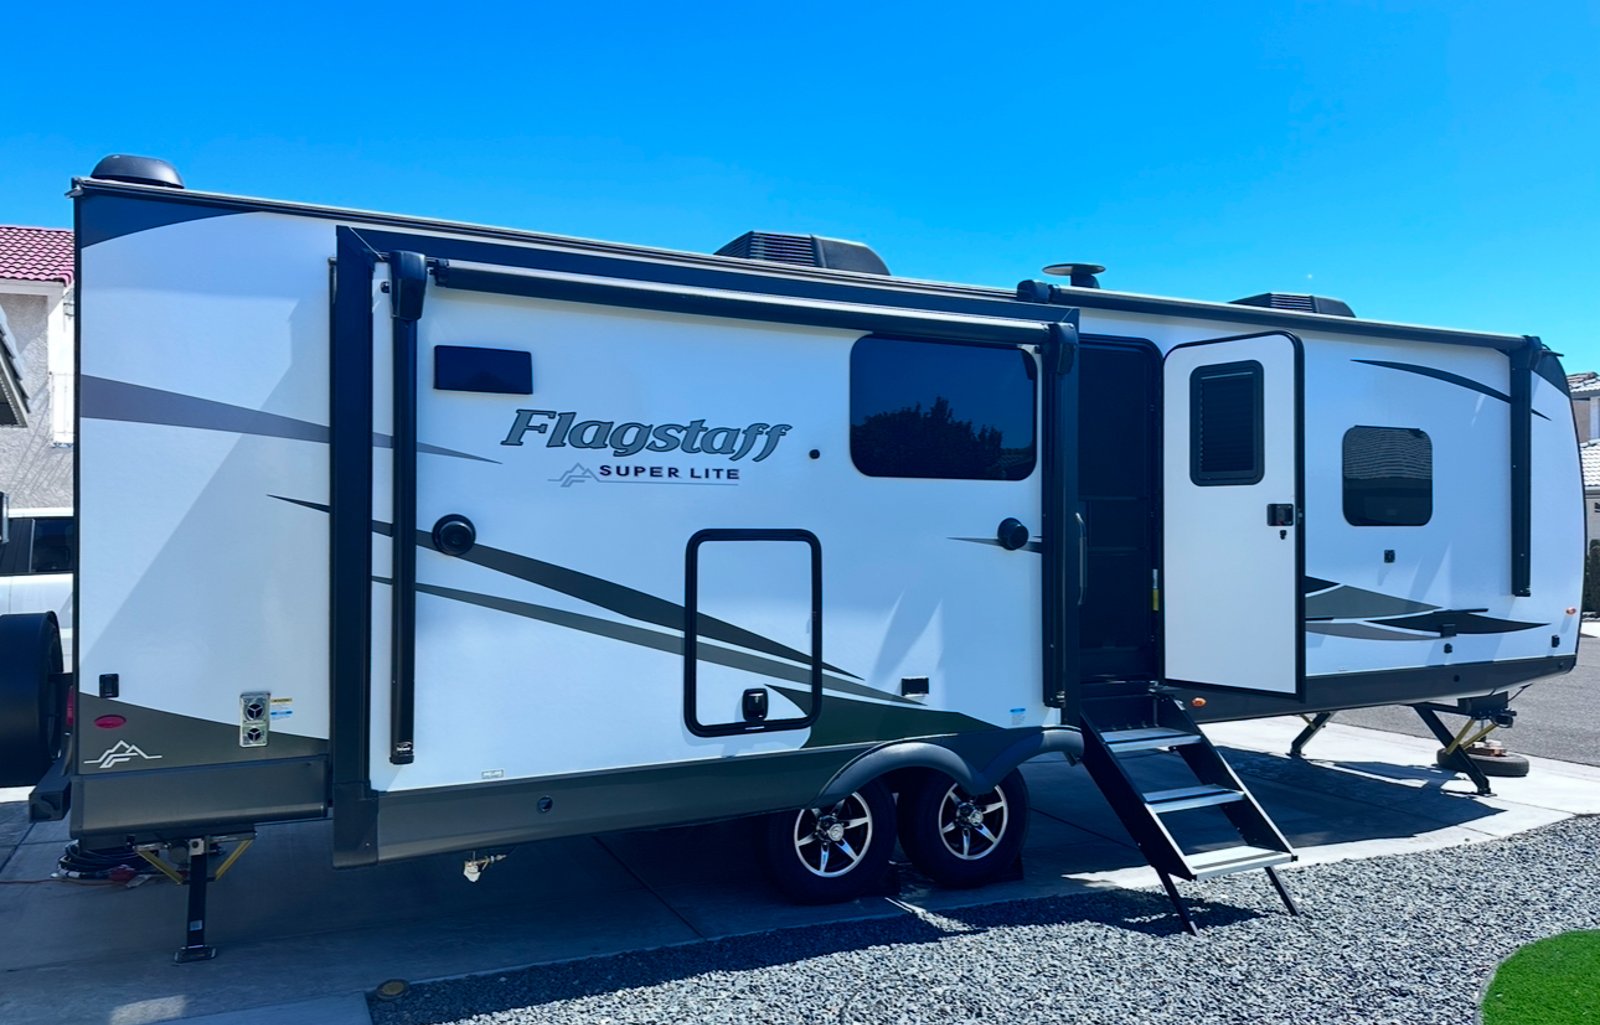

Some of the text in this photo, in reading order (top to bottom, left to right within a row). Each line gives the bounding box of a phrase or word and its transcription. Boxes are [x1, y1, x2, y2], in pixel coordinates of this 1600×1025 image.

[500, 408, 793, 463] Flagstaff
[599, 464, 740, 480] SUPER LITE
